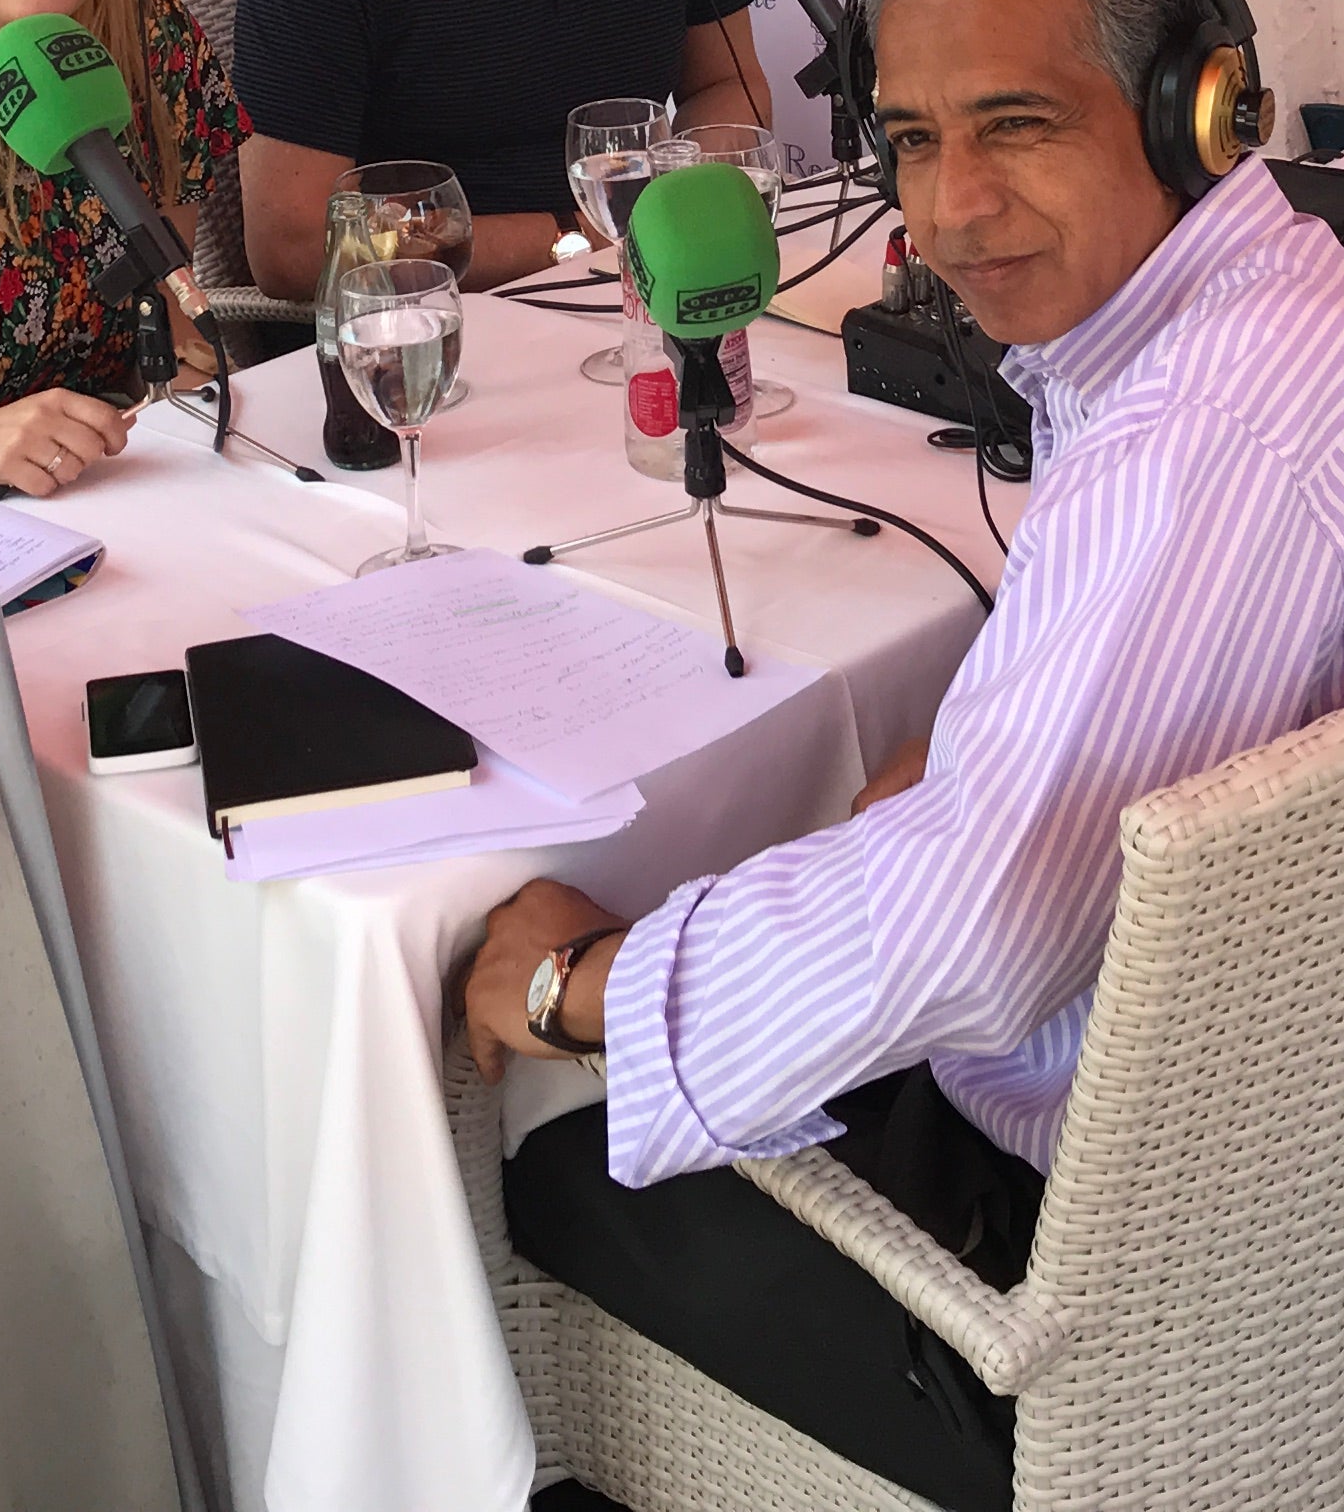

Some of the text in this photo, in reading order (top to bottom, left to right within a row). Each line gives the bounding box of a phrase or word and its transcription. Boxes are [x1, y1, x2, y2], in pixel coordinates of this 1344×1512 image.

[65, 49, 105, 68] CERO
[0, 88, 25, 122] CERO
[690, 288, 749, 307] ONDA
[693, 301, 751, 320] CERO
